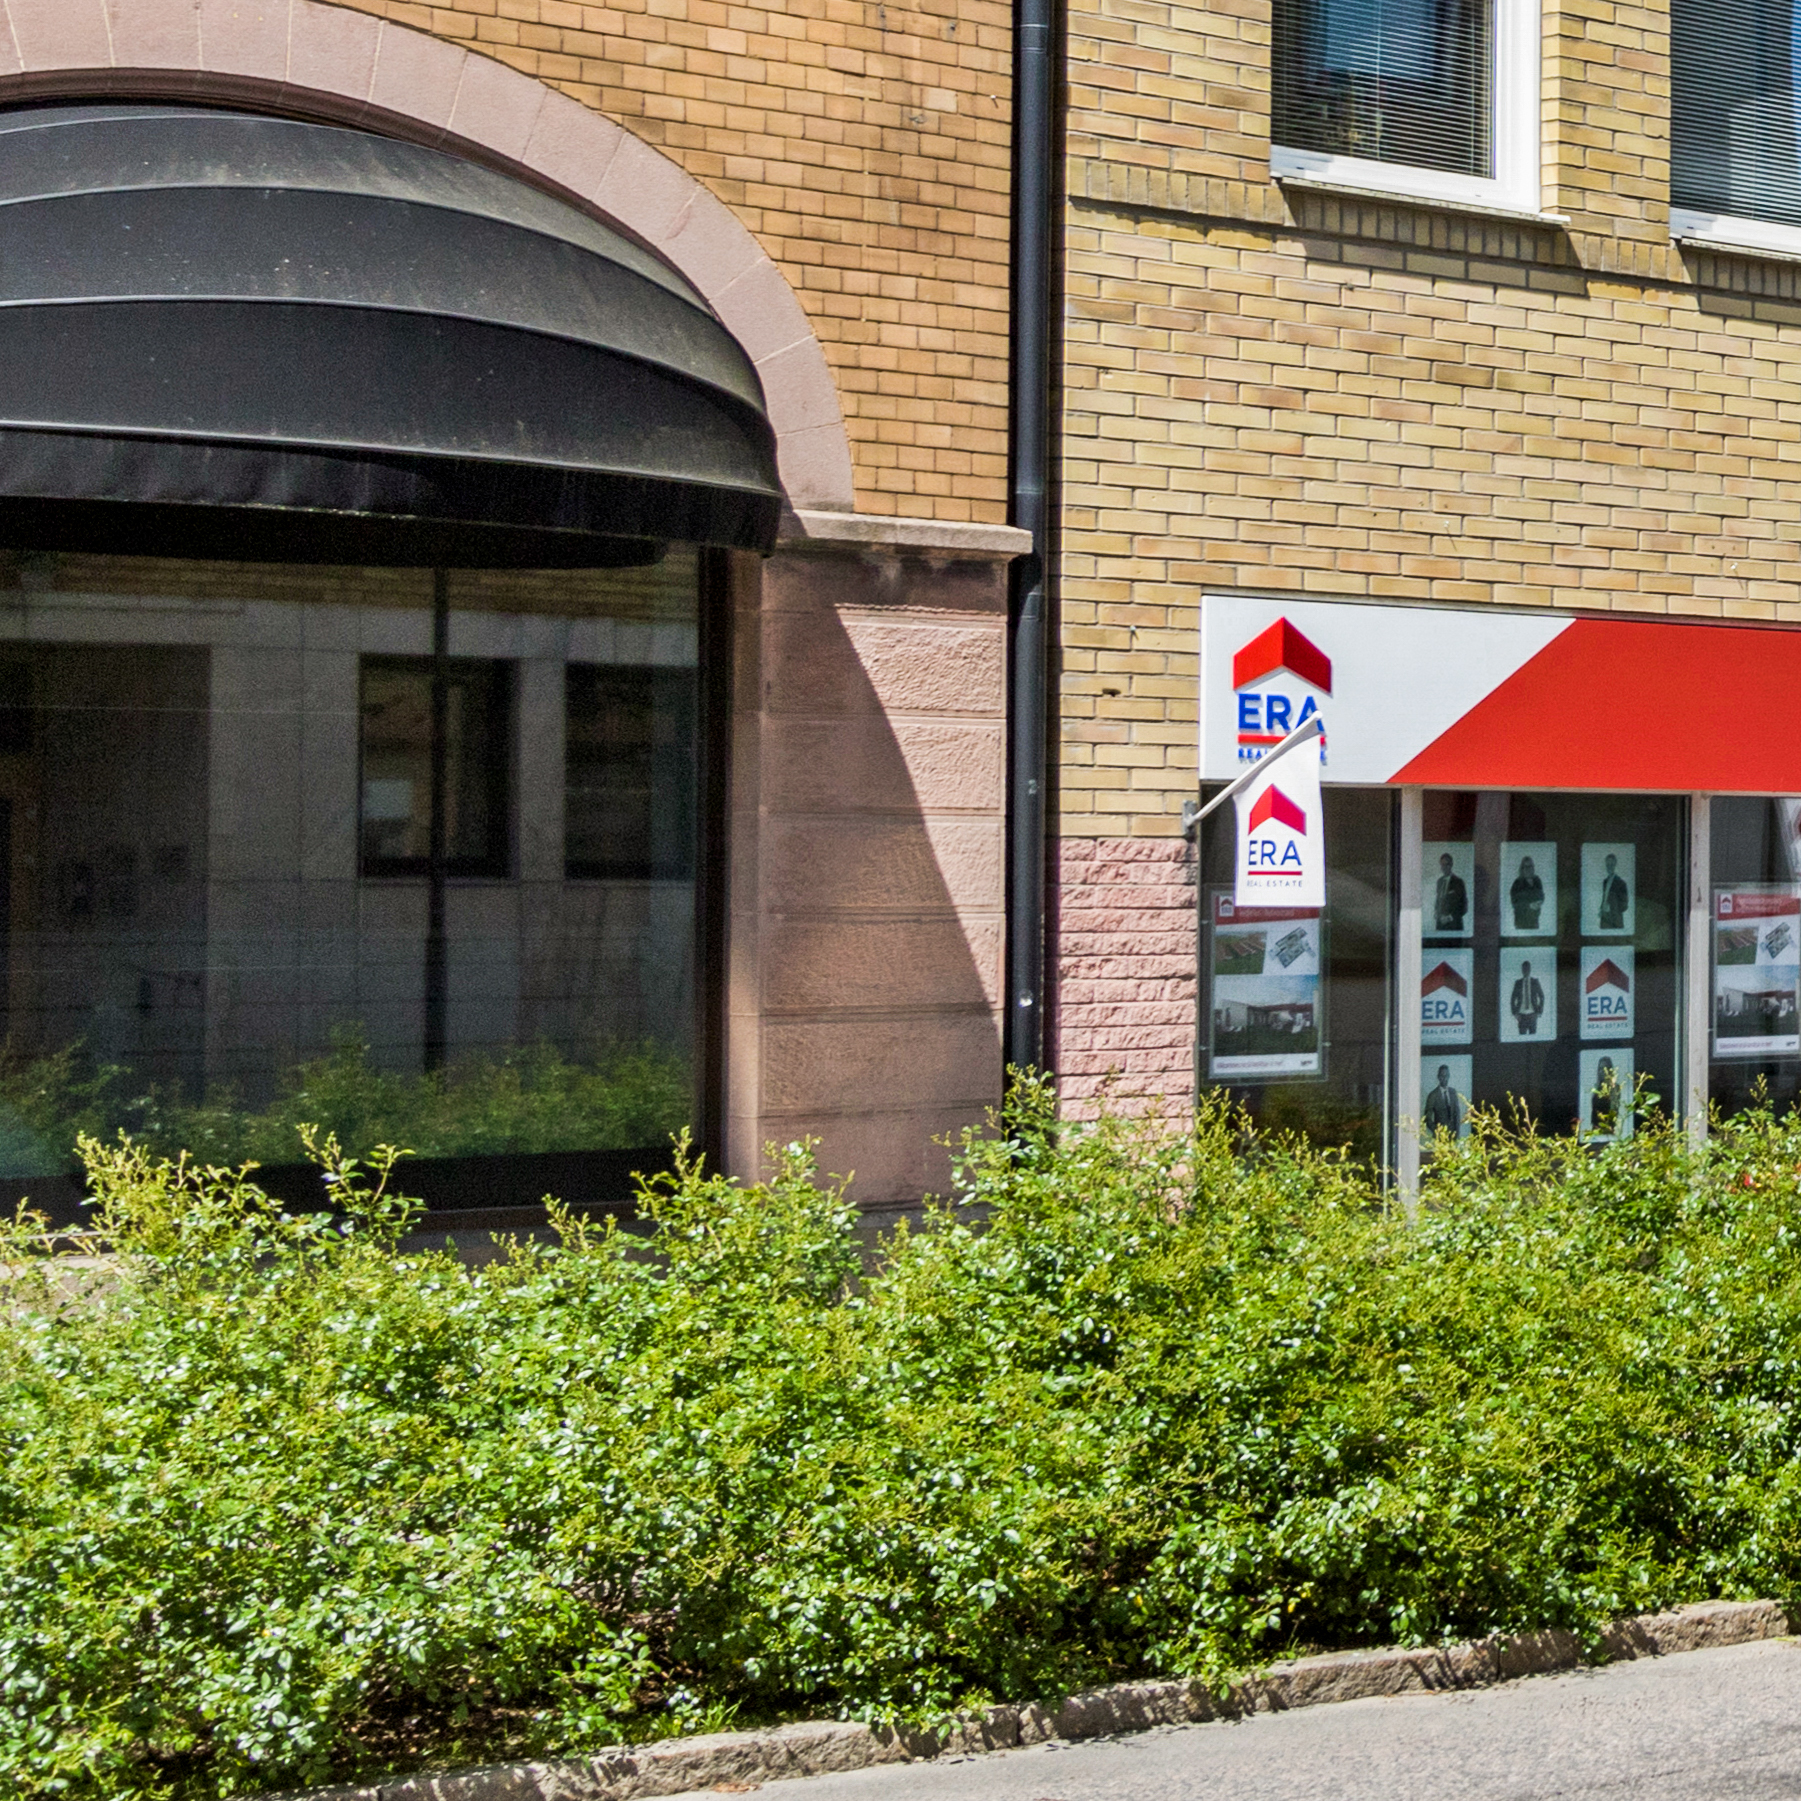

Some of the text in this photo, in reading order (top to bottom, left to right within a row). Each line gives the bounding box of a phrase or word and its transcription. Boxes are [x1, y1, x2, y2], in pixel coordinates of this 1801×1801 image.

[1238, 693, 1325, 731] ERA
[1238, 747, 1267, 759] REA
[1248, 840, 1303, 866] ERA
[1266, 879, 1303, 888] ESTATE
[1422, 1000, 1465, 1019] ERA
[1587, 996, 1628, 1015] ERA
